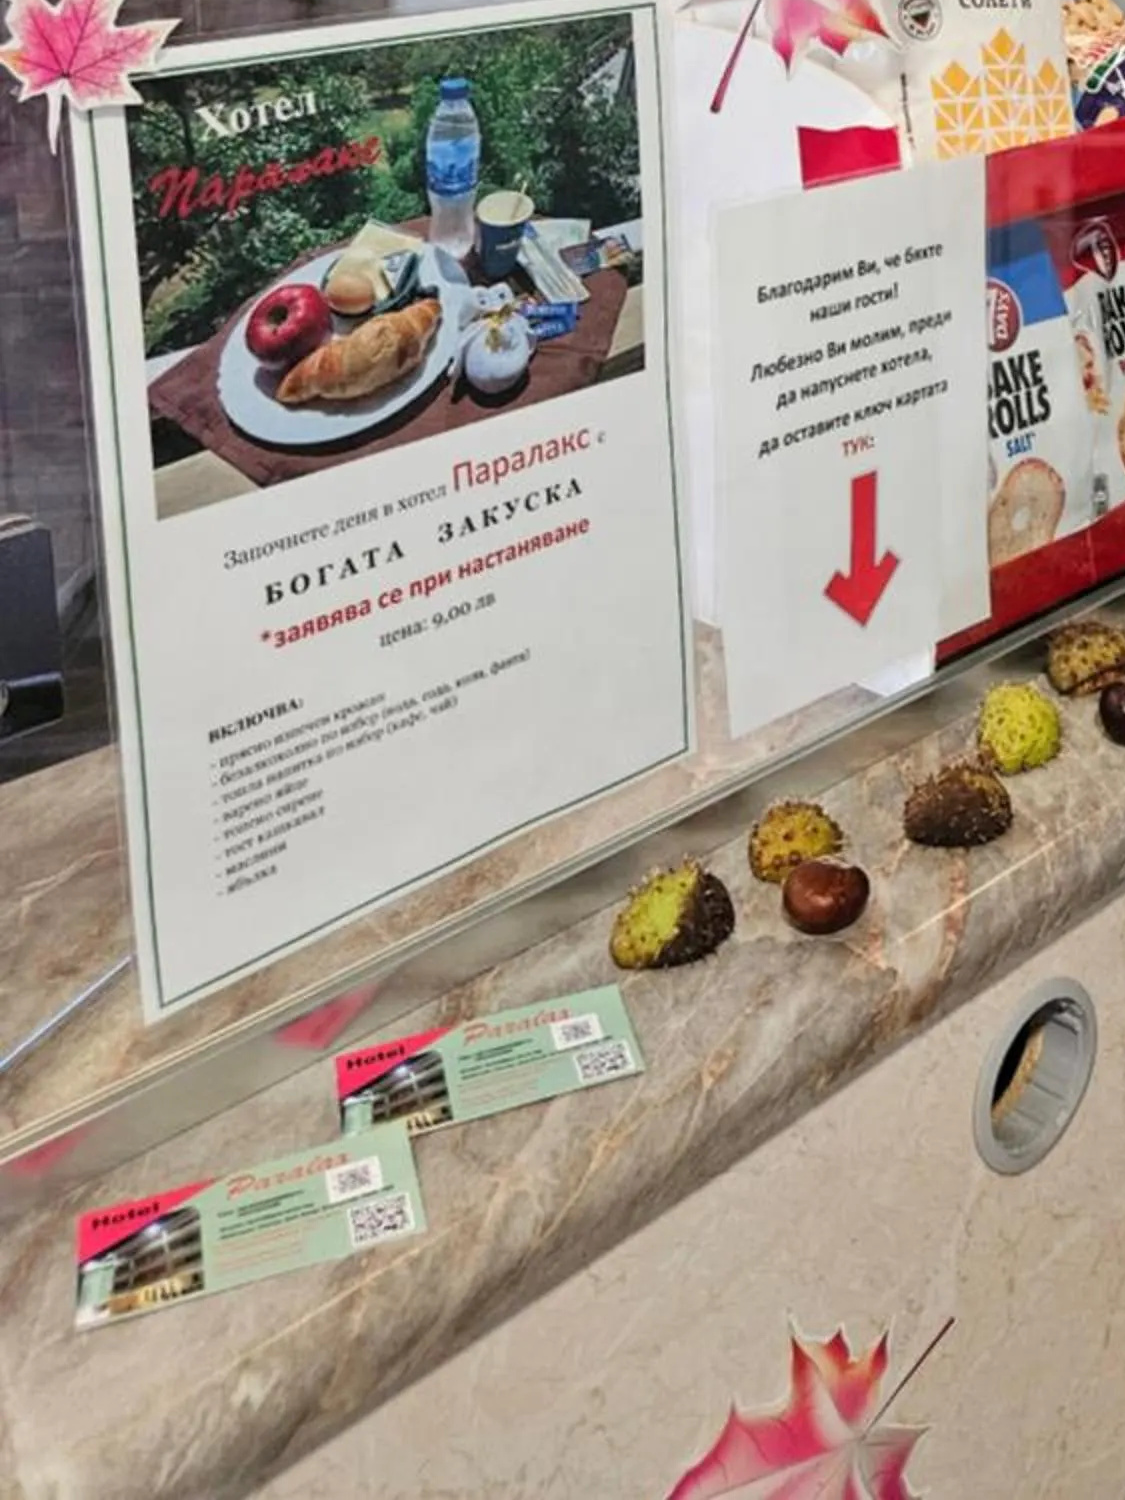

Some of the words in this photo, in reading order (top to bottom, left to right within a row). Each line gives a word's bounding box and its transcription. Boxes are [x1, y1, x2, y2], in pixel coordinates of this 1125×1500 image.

[195, 88, 317, 142] Хотел
[757, 265, 855, 304] Благодарим
[856, 259, 881, 278] Ви,
[884, 253, 902, 269] че
[904, 242, 944, 264] бяхте
[809, 297, 852, 323] наши
[854, 282, 900, 310] гости!
[750, 347, 824, 383] Любезно
[826, 342, 847, 359] Ви
[849, 323, 906, 351] молим,
[908, 309, 953, 335] преди
[775, 392, 798, 411] да
[800, 361, 879, 400] напуснете
[880, 347, 934, 375] хотела,
[988, 348, 1044, 399] AKE
[758, 441, 780, 459] да
[783, 411, 851, 447] оставите
[853, 399, 893, 424] ключ
[895, 378, 949, 409] картата
[1005, 432, 1037, 458] SALT
[841, 435, 877, 458] ТУК:
[223, 525, 331, 570] Започнете
[332, 509, 380, 538] деня
[383, 505, 395, 518] в
[397, 483, 448, 514] хотел
[452, 426, 591, 493] Паралакс
[264, 540, 406, 605] БОГАТА
[438, 477, 583, 544] ЗАКУСКА
[378, 586, 404, 610] се
[409, 566, 453, 604] при
[457, 516, 591, 582] настаняване
[379, 620, 428, 649] цена:
[344, 1044, 407, 1072] Hotel
[90, 1200, 161, 1232] Hotel
